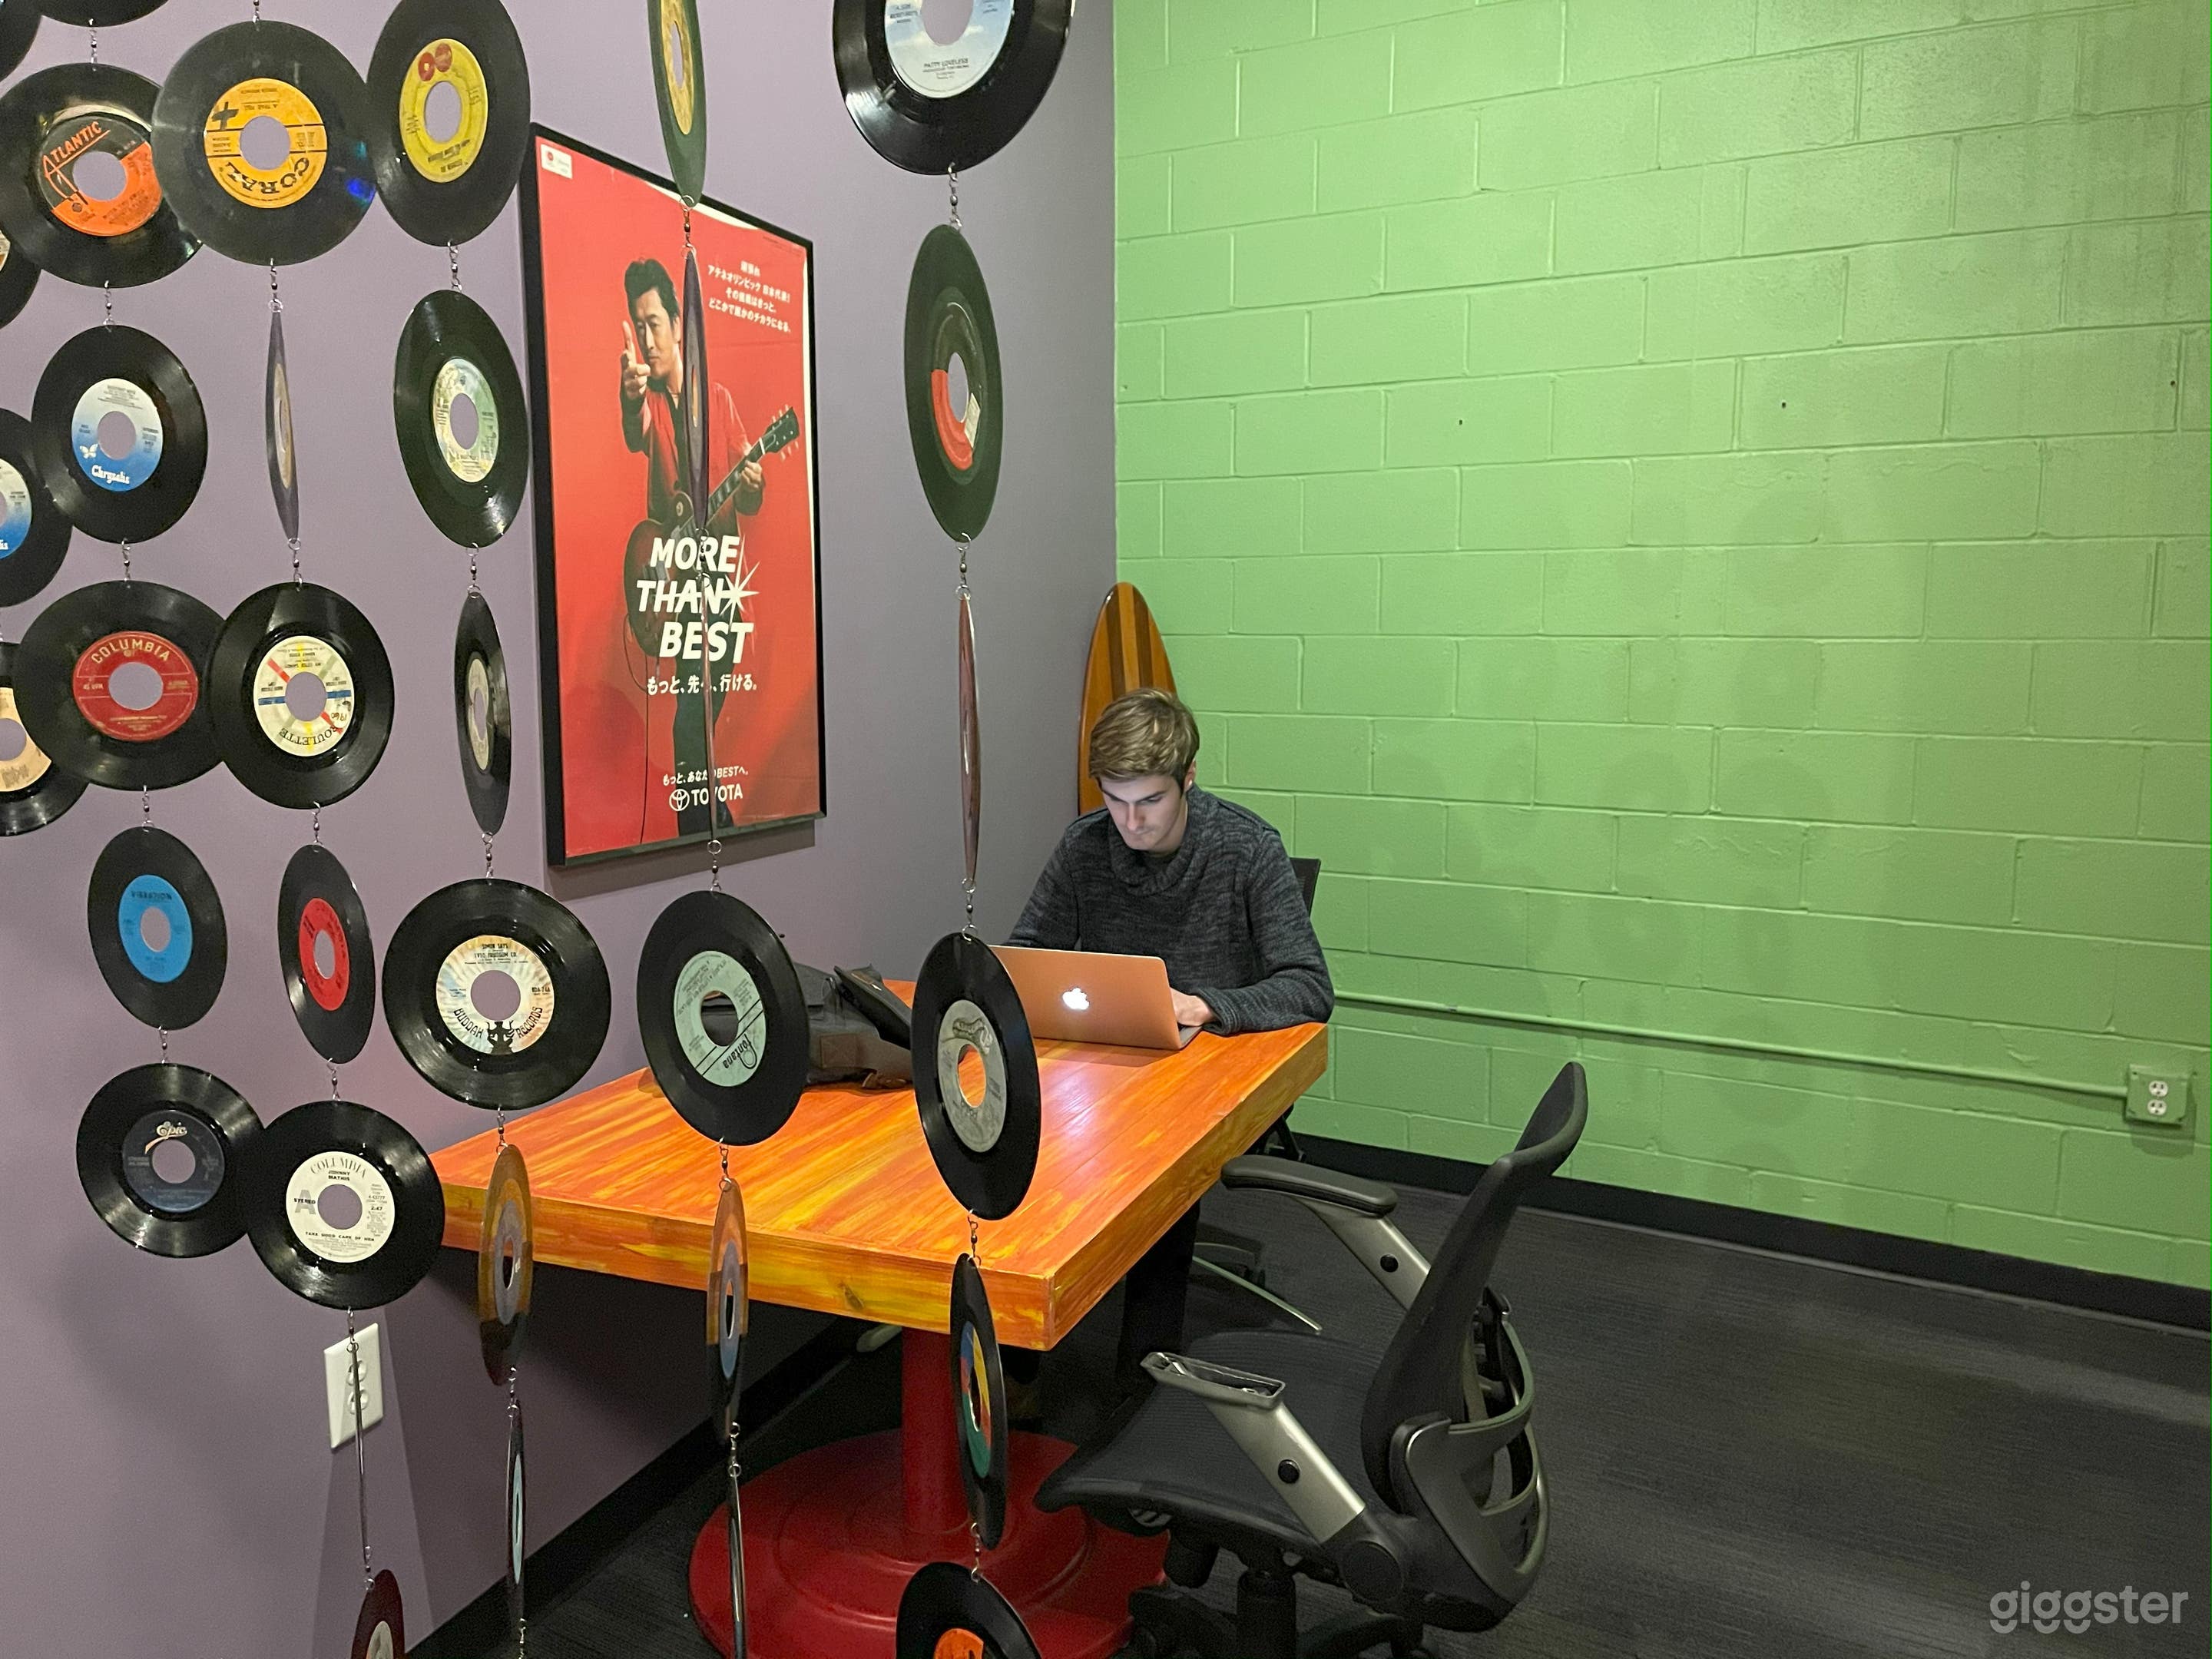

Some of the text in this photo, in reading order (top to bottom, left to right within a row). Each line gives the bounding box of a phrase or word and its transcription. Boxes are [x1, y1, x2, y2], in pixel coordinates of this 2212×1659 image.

[225, 157, 310, 194] CORAL
[650, 535, 740, 573] MORE
[636, 577, 724, 614] THAN
[91, 638, 171, 664] COLUMBIA
[659, 621, 754, 664] BEST
[663, 765, 749, 786] もっと、あなたBESTへ。
[690, 783, 743, 806] TOOTA
[156, 1121, 188, 1140] Epic
[310, 1157, 366, 1178] COLUMBIA
